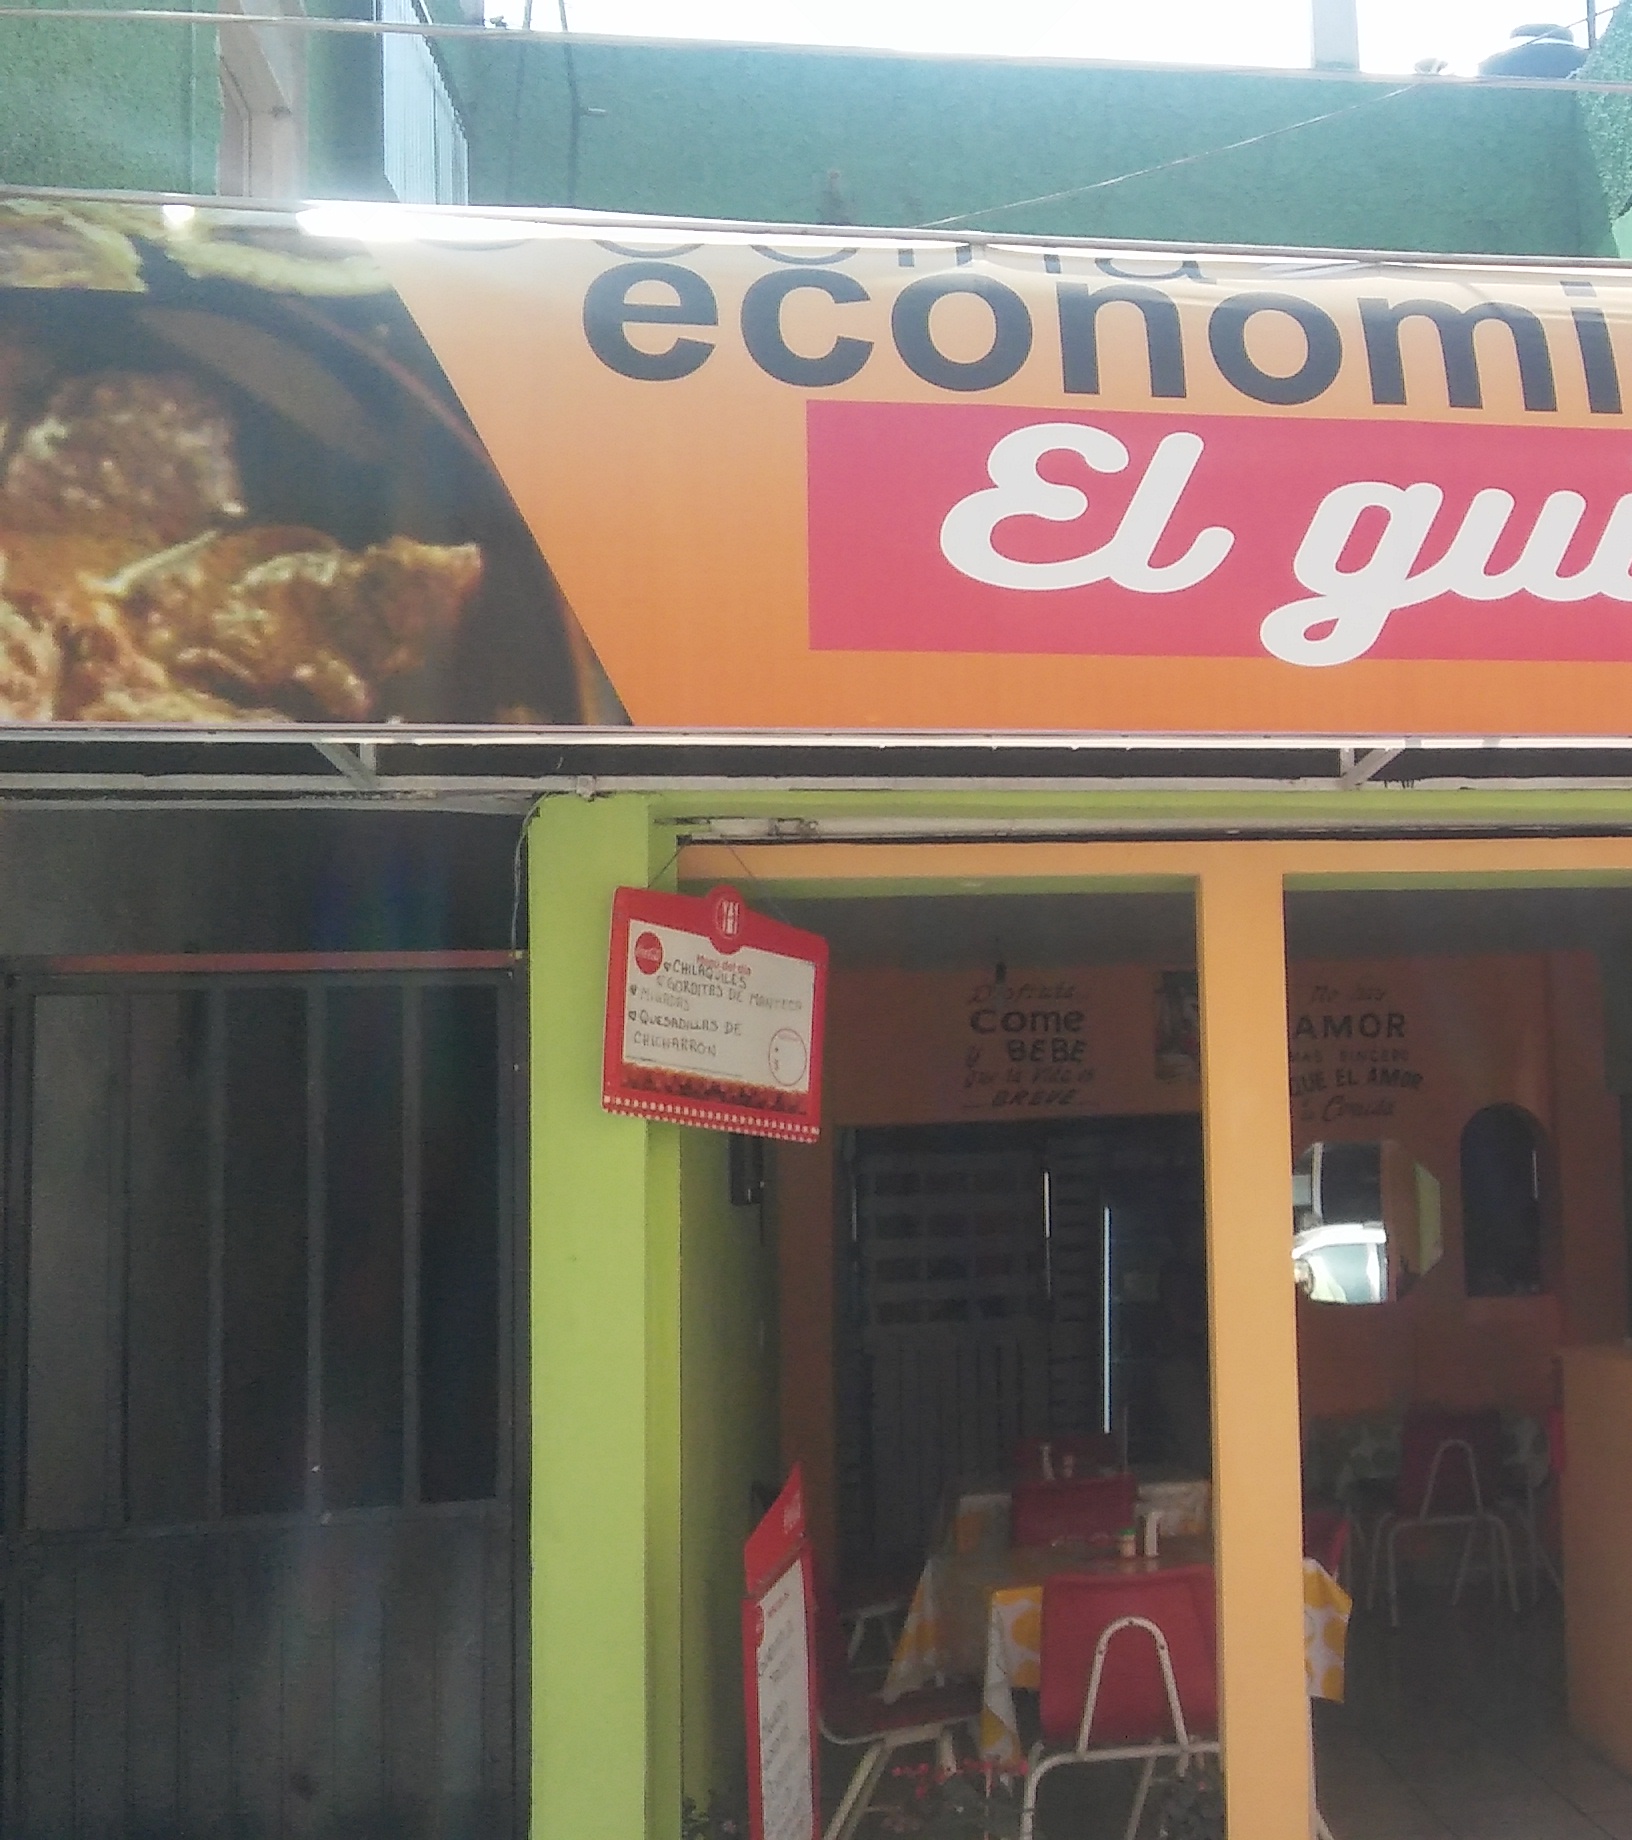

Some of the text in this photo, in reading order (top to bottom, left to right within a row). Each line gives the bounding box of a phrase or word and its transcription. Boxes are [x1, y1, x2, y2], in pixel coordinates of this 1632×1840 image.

[939, 423, 1235, 593] El
[639, 1008, 744, 1036] QUESADILLAS DE
[970, 1008, 1086, 1034] Come
[1293, 1012, 1406, 1040] AMOR
[633, 1030, 717, 1057] CHICHARRON
[1006, 1037, 1088, 1064] BEBE
[1335, 1068, 1361, 1088] EL
[1366, 1067, 1426, 1092] AMOR
